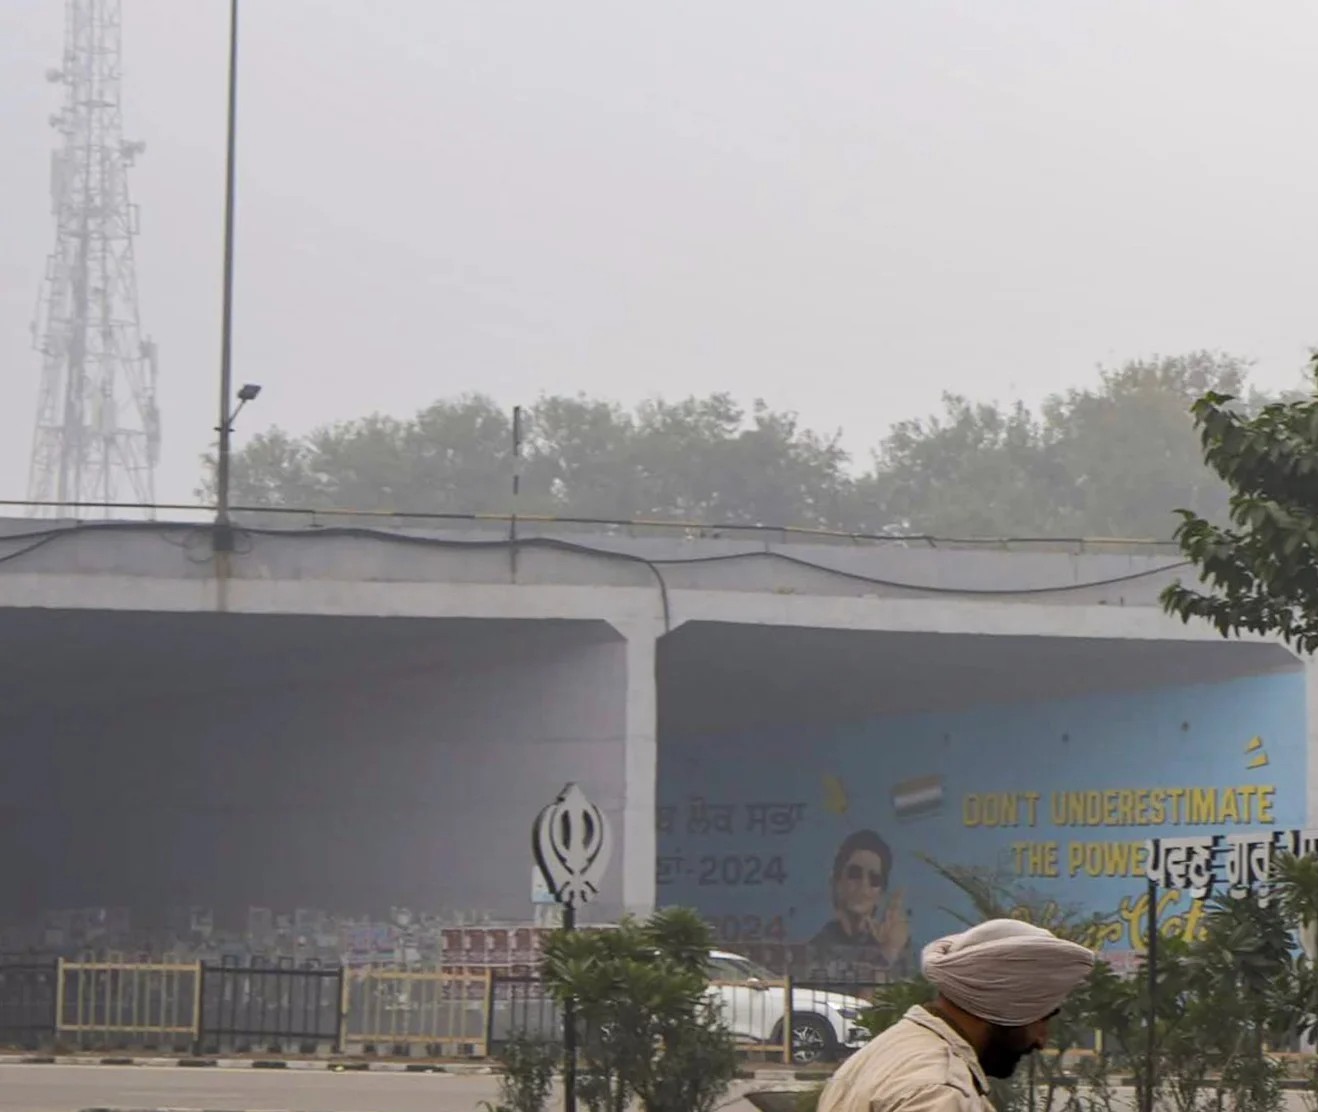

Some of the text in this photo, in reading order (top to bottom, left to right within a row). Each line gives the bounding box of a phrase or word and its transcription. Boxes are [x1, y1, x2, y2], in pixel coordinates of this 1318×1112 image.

[963, 785, 1275, 828] DON'T UNDERESTIMATE
[1013, 839, 1148, 878] THE POWE
